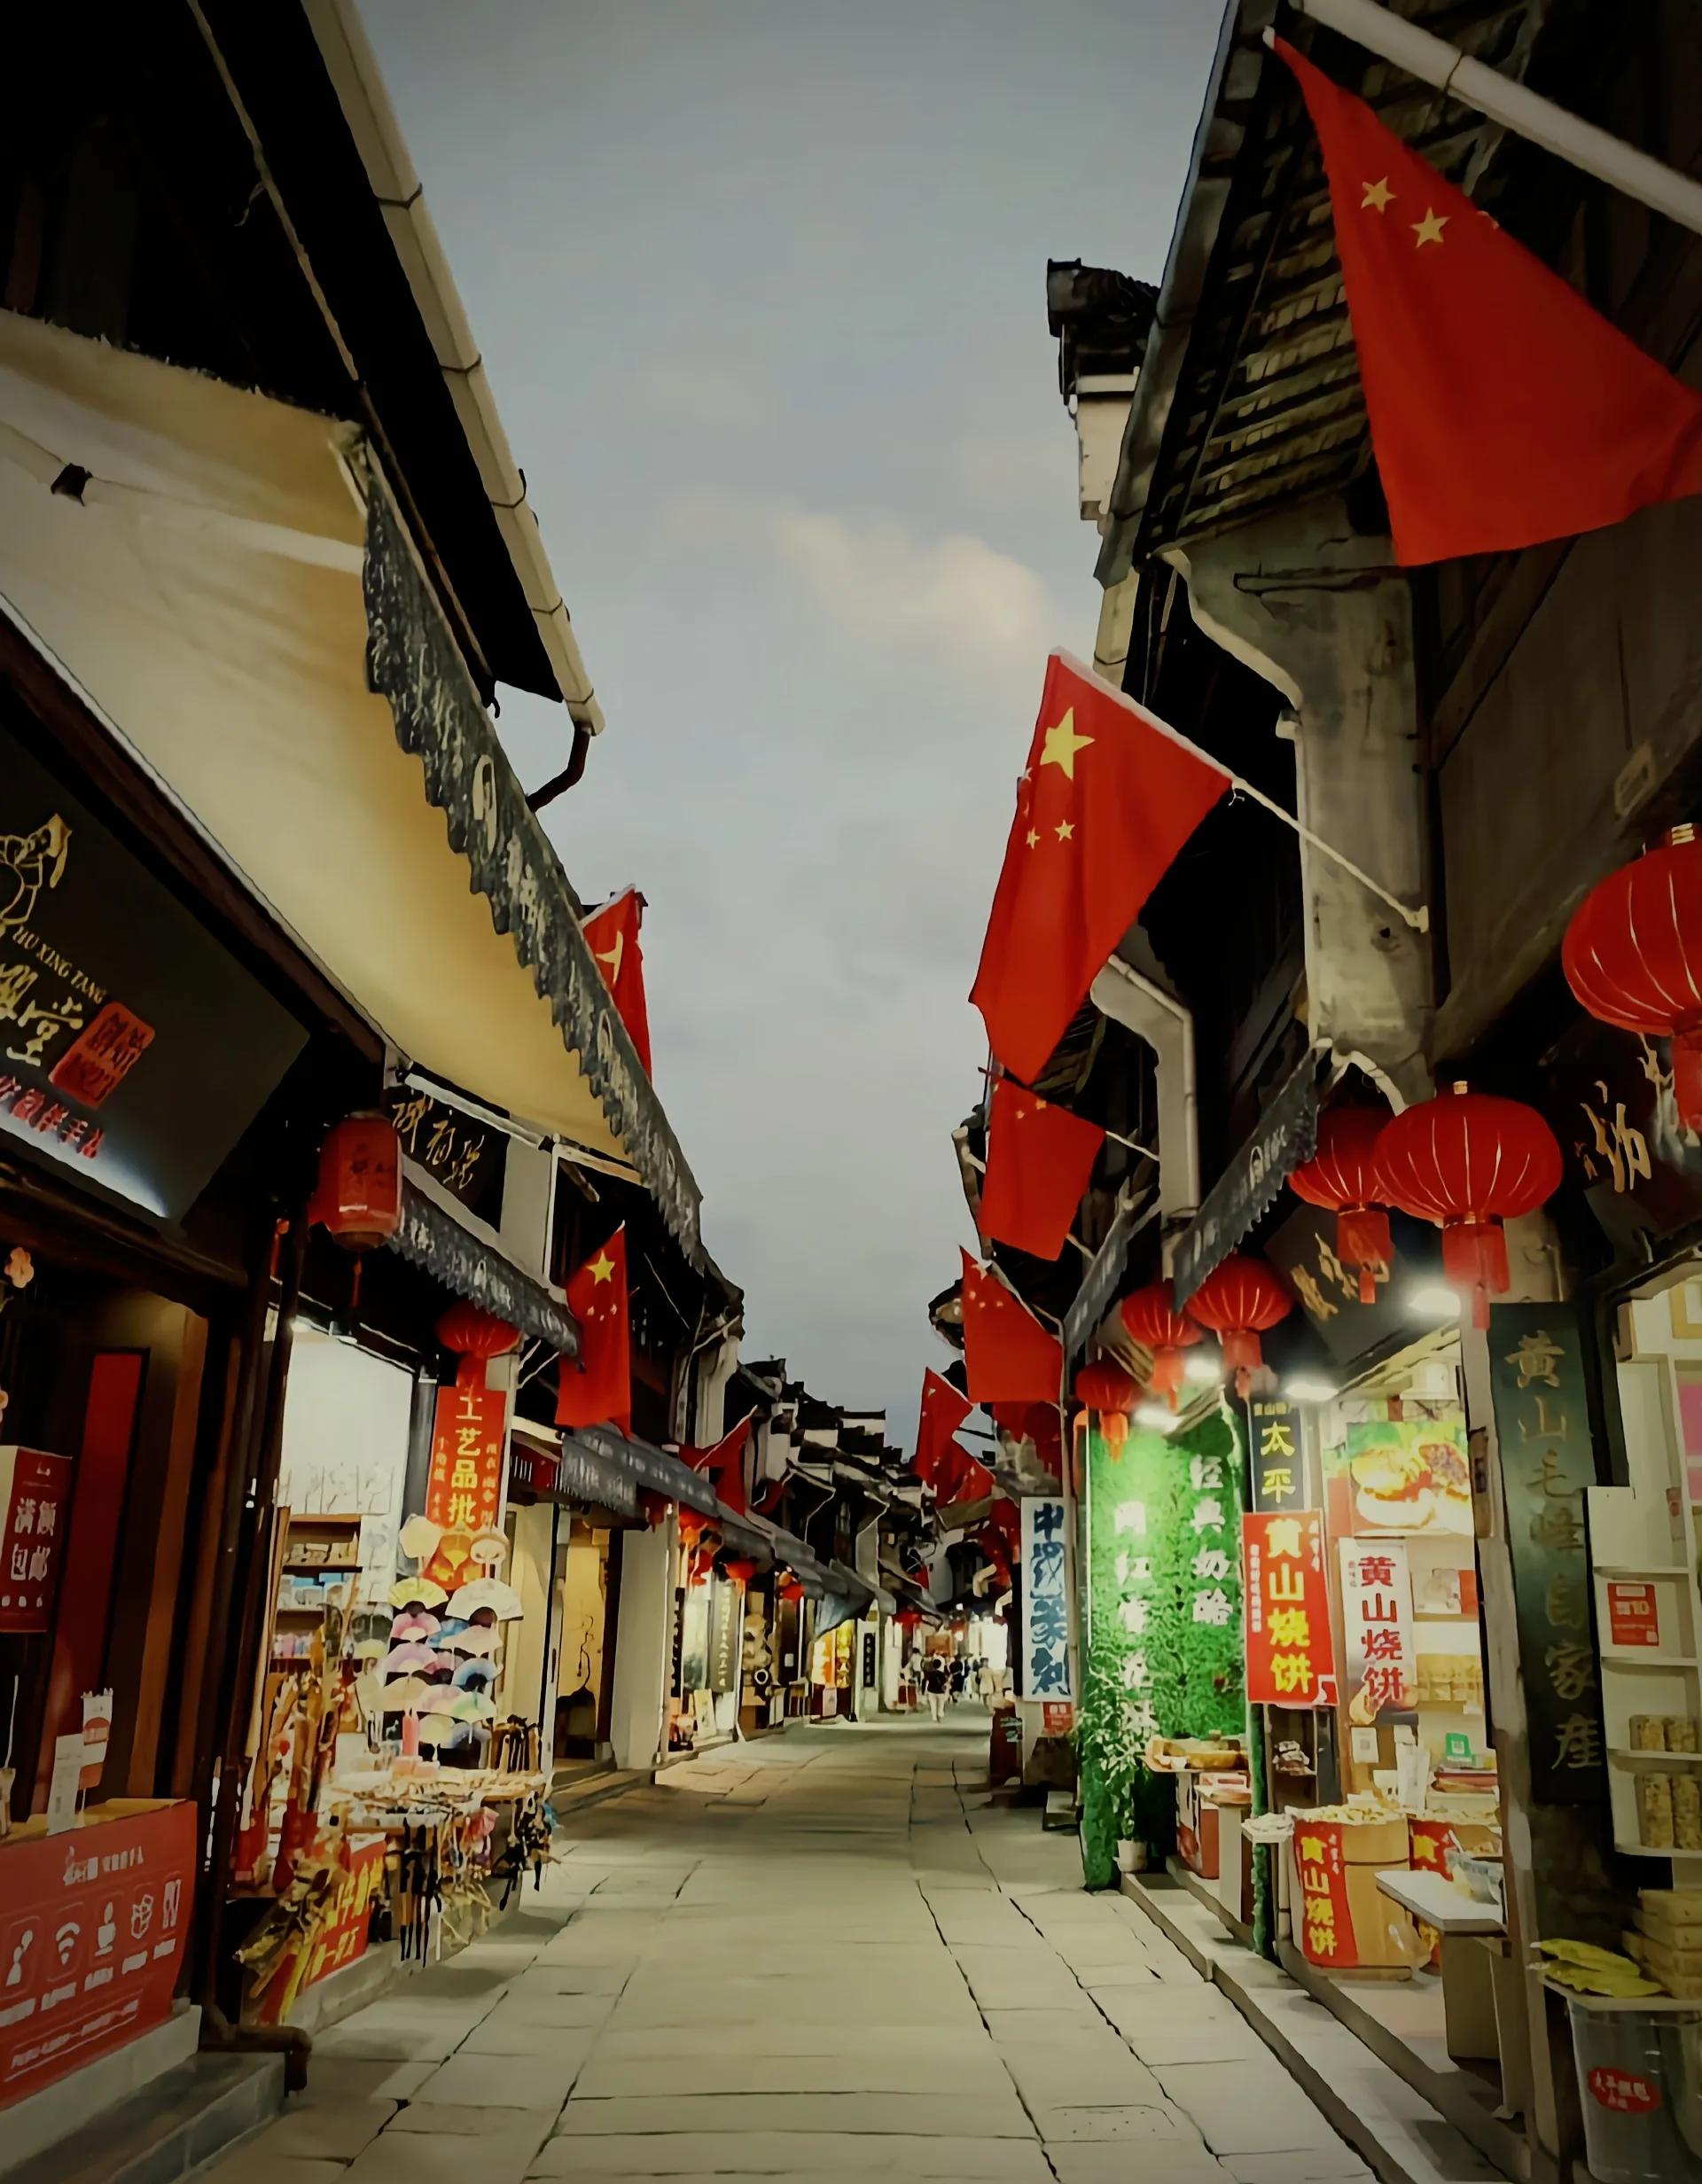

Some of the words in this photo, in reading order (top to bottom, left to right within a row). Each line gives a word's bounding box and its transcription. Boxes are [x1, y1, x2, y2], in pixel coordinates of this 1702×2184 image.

[36, 944, 72, 978] XING
[1260, 1422, 1296, 1504] 太平
[1264, 1517, 1313, 1694] 黄山烧饼
[1358, 1556, 1404, 1701] 黄山烧饼
